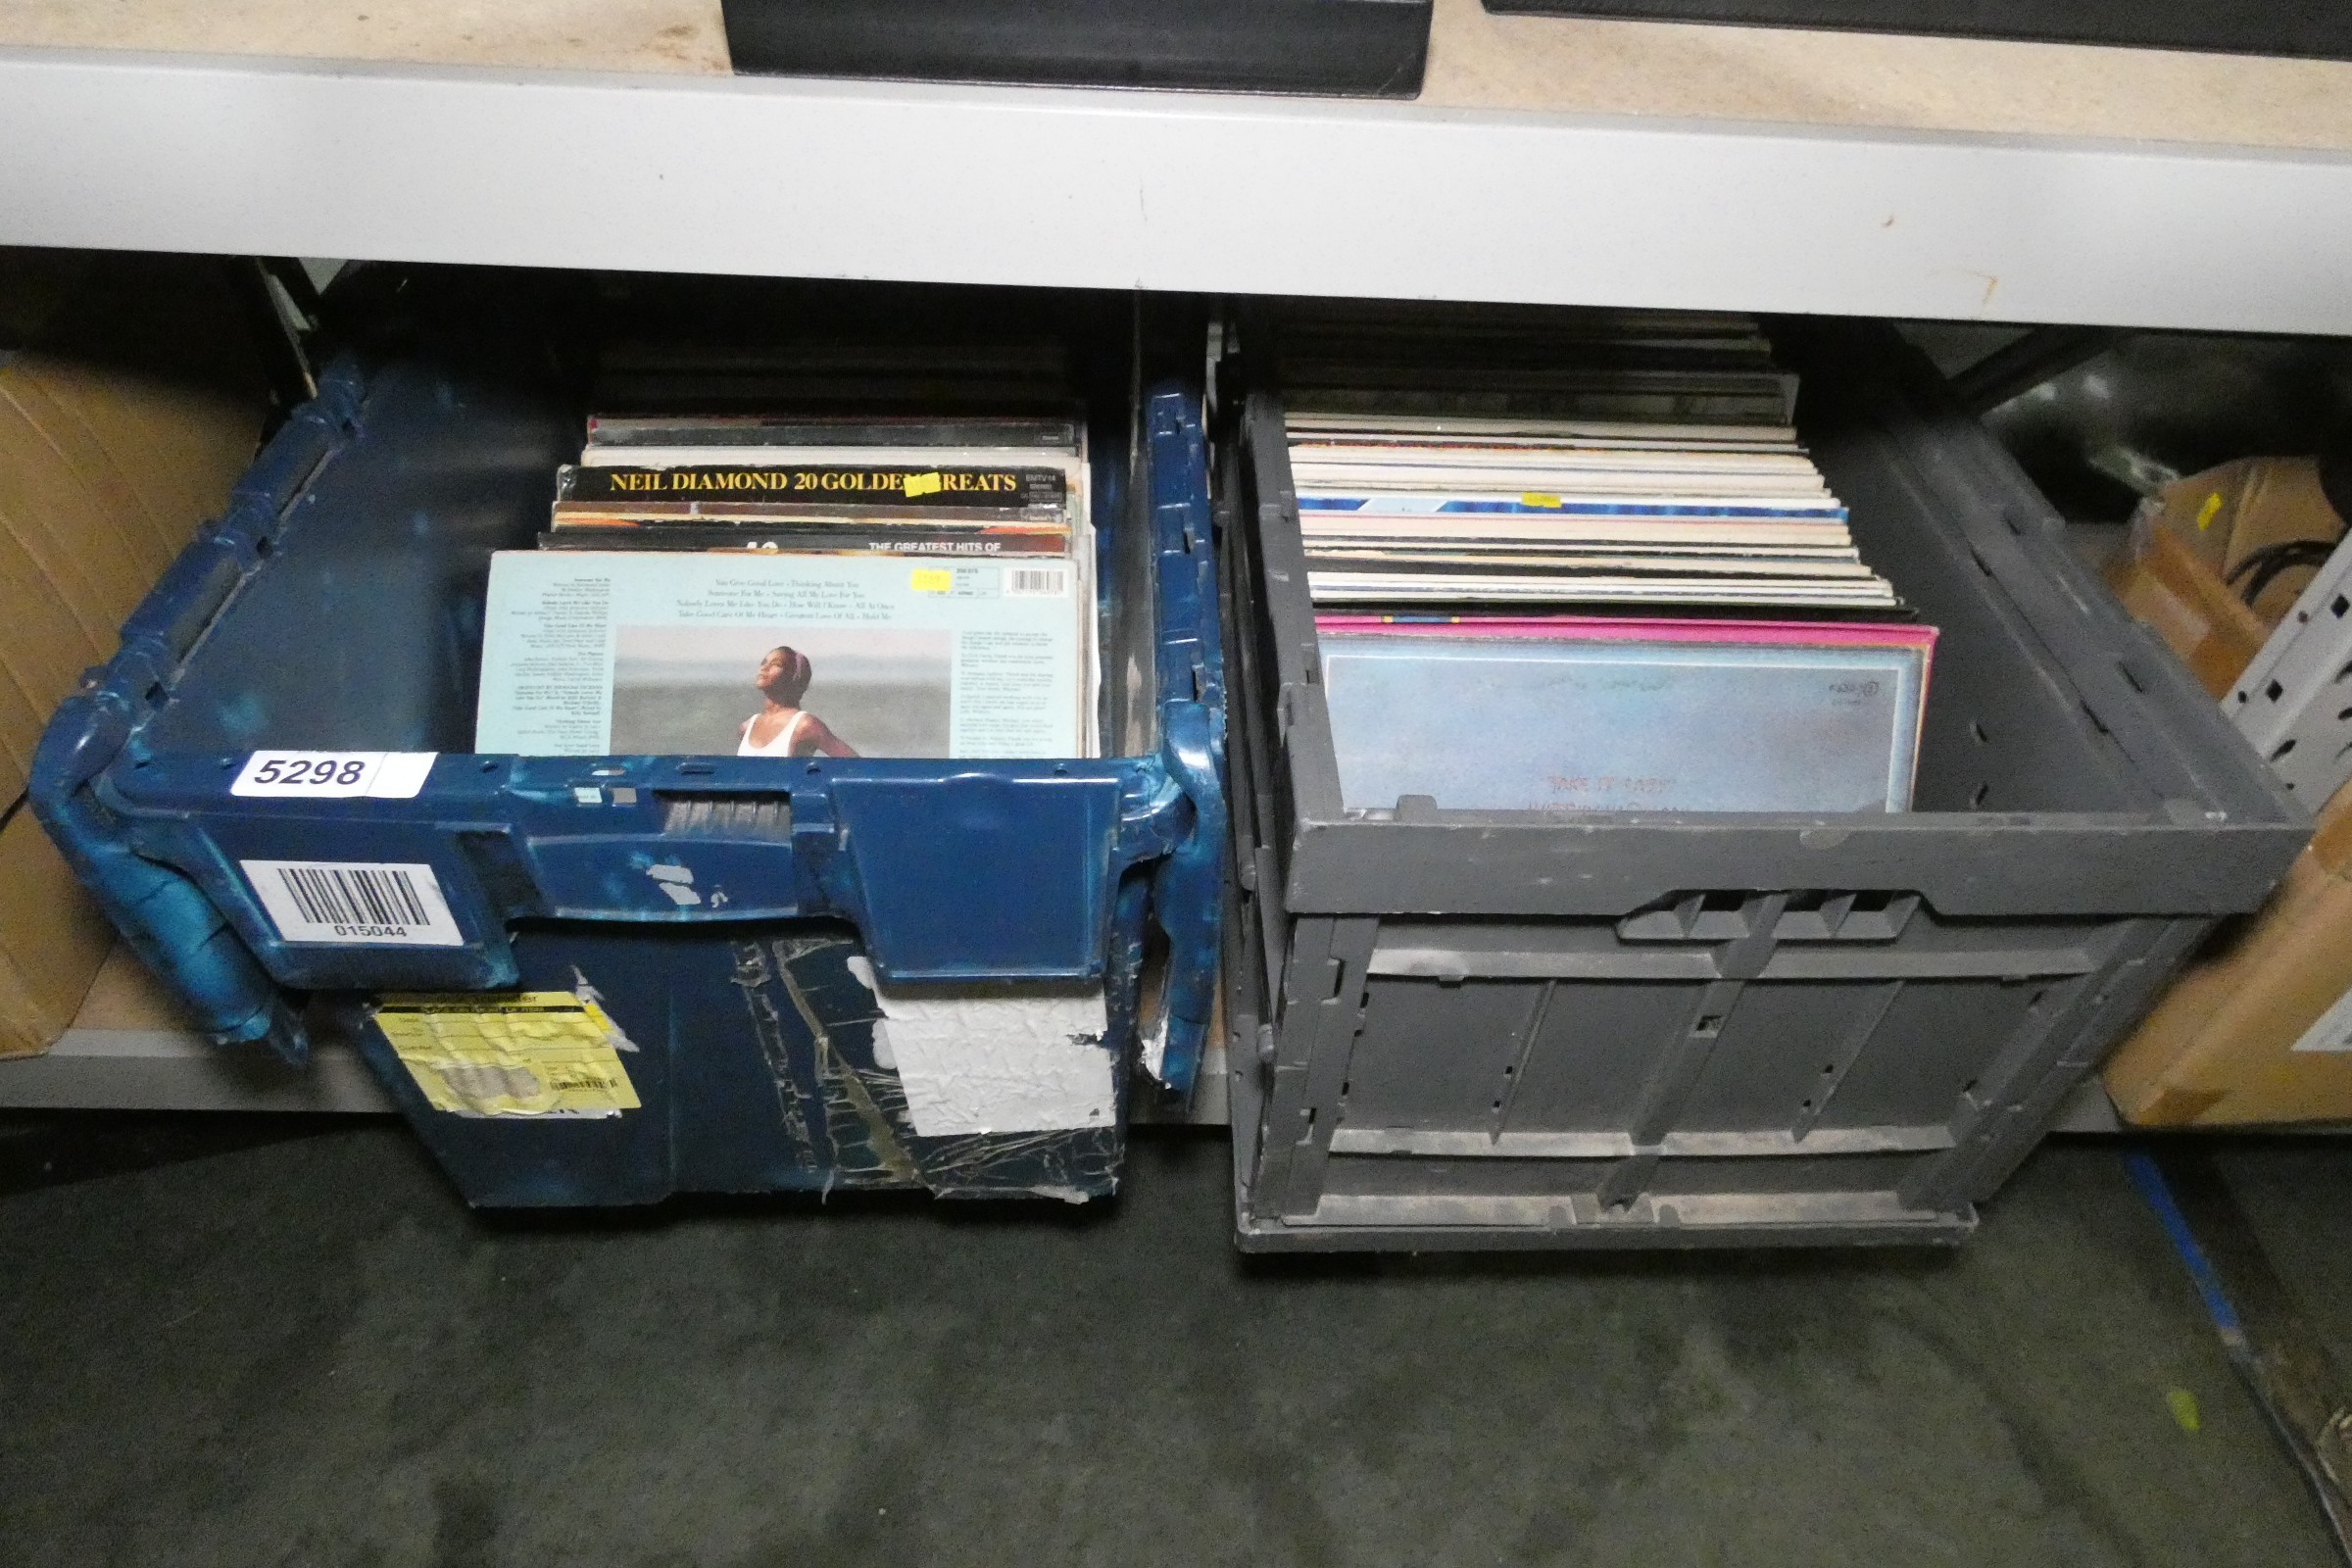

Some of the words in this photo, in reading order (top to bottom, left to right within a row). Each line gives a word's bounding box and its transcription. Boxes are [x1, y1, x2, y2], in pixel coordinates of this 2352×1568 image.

[611, 473, 667, 491] NEIL
[672, 472, 788, 491] DIAMOND
[794, 472, 817, 490] 20
[821, 472, 922, 491] GOLDE
[925, 473, 1017, 491] REATS
[894, 542, 954, 552] GREATEST
[956, 542, 983, 552] HITS
[985, 542, 1002, 553] OF
[254, 760, 366, 785] 5298
[334, 925, 407, 937] 015044
